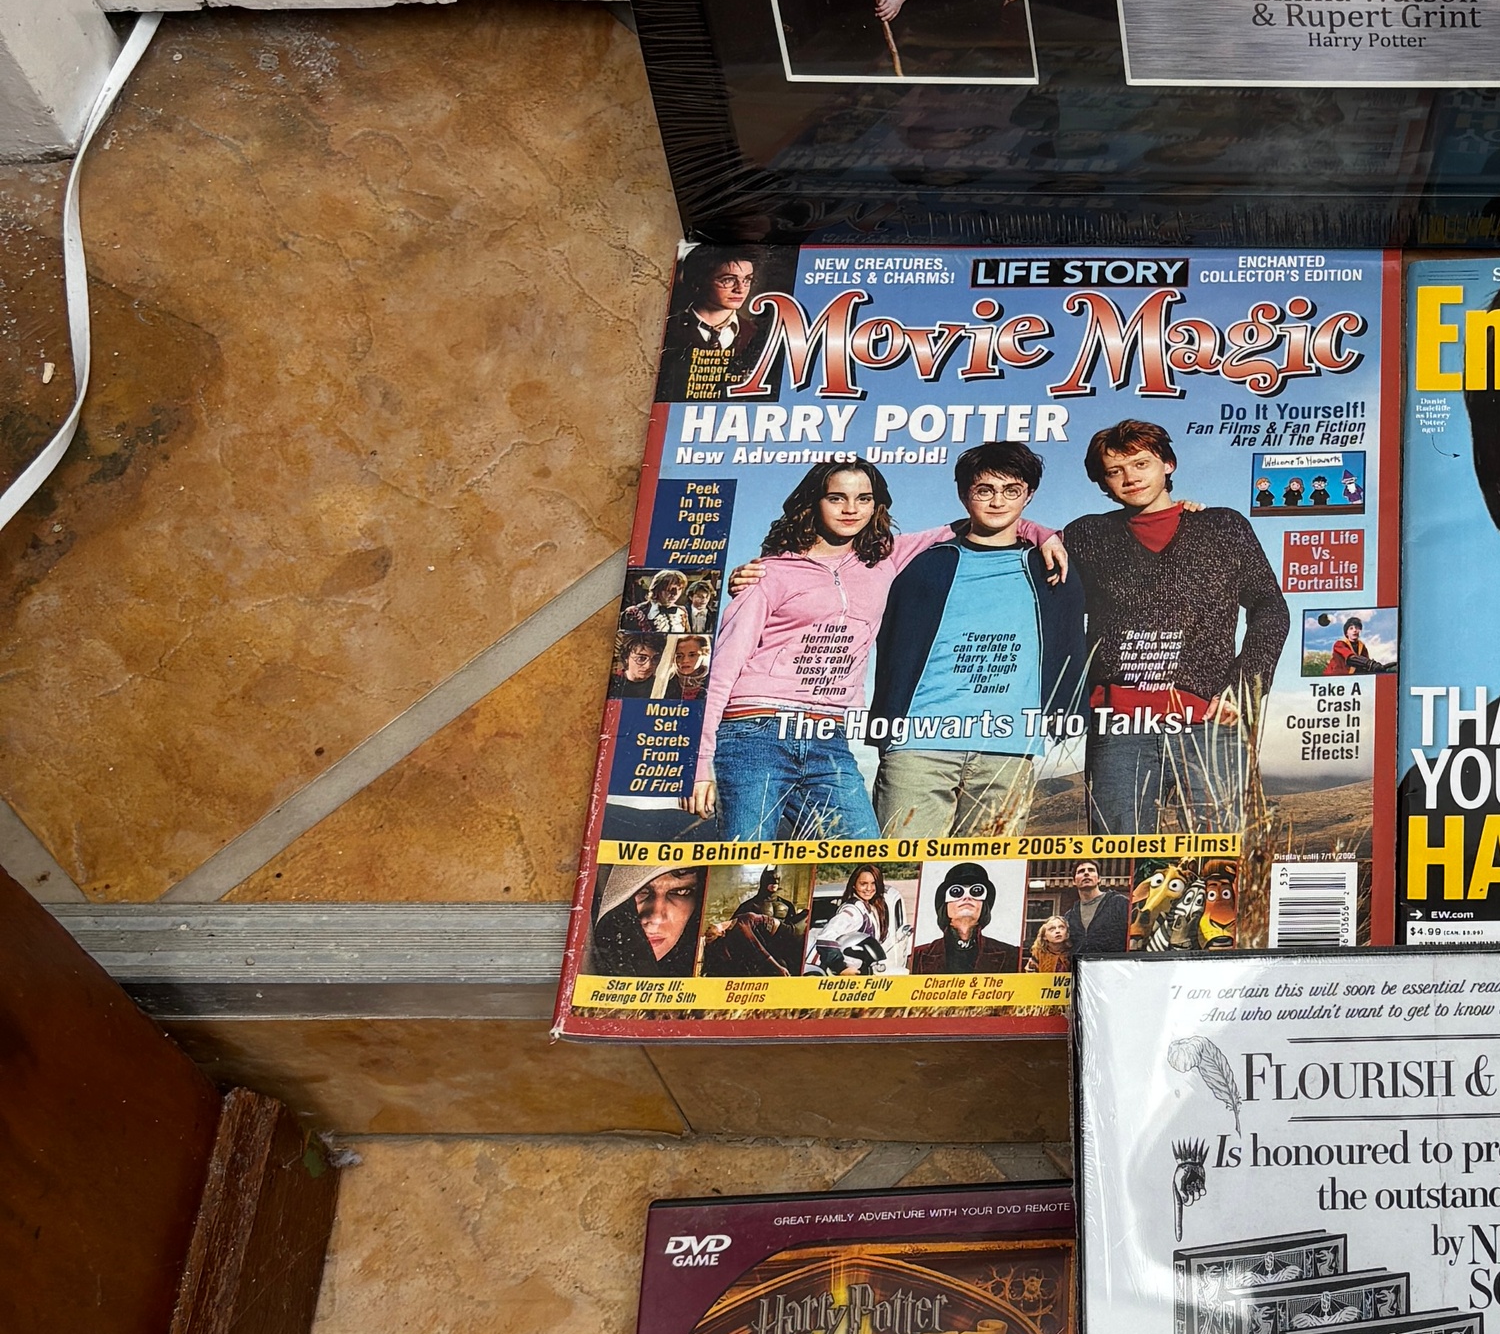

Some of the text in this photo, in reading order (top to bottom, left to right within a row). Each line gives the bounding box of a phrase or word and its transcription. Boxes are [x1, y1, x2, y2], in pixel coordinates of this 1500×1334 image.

[1252, 4, 1482, 34] & Rupert Grint
[1308, 33, 1426, 51] Harry Potter
[813, 257, 948, 273] NEW CREATURES,
[1238, 255, 1326, 269] ENCHANTED
[804, 271, 955, 286] SPELLS & CHARMS!
[977, 261, 1185, 286] LIFE STORY
[1200, 268, 1363, 283] COLLECTOR'S EDITION
[727, 288, 1365, 399] Movie Magic
[1220, 402, 1365, 420] Do It Yourself!
[680, 404, 1070, 443] HARRY POTTER
[1186, 421, 1366, 434] Fan Films & Fan Fiction
[675, 447, 947, 465] New Adventures Unfold!
[1290, 531, 1358, 545] Reel Life
[1312, 547, 1335, 560] Vs.
[1289, 561, 1358, 575] Real Life
[1287, 577, 1358, 590] Portraits!
[775, 706, 1193, 746] The Hogwarts Trio Talks!
[618, 836, 1236, 861] We Go Behind-The-Scenes Of Summer 2005's Coolest Films!
[1431, 910, 1474, 919] EW.com
[1410, 927, 1441, 936] $4.99
[1241, 1052, 1456, 1101] FLOURISH
[1466, 1054, 1497, 1097] &
[1214, 1135, 1242, 1168] Is
[1249, 1130, 1409, 1167] honoured
[1418, 1137, 1452, 1164] to
[1318, 1177, 1366, 1211] the
[774, 1203, 1070, 1226] GREAT FAMILY ADVENTURE WITH YOUR DVD REMOTE
[665, 1234, 732, 1255] DVD
[1432, 1226, 1464, 1266] by
[672, 1254, 719, 1267] GAME
